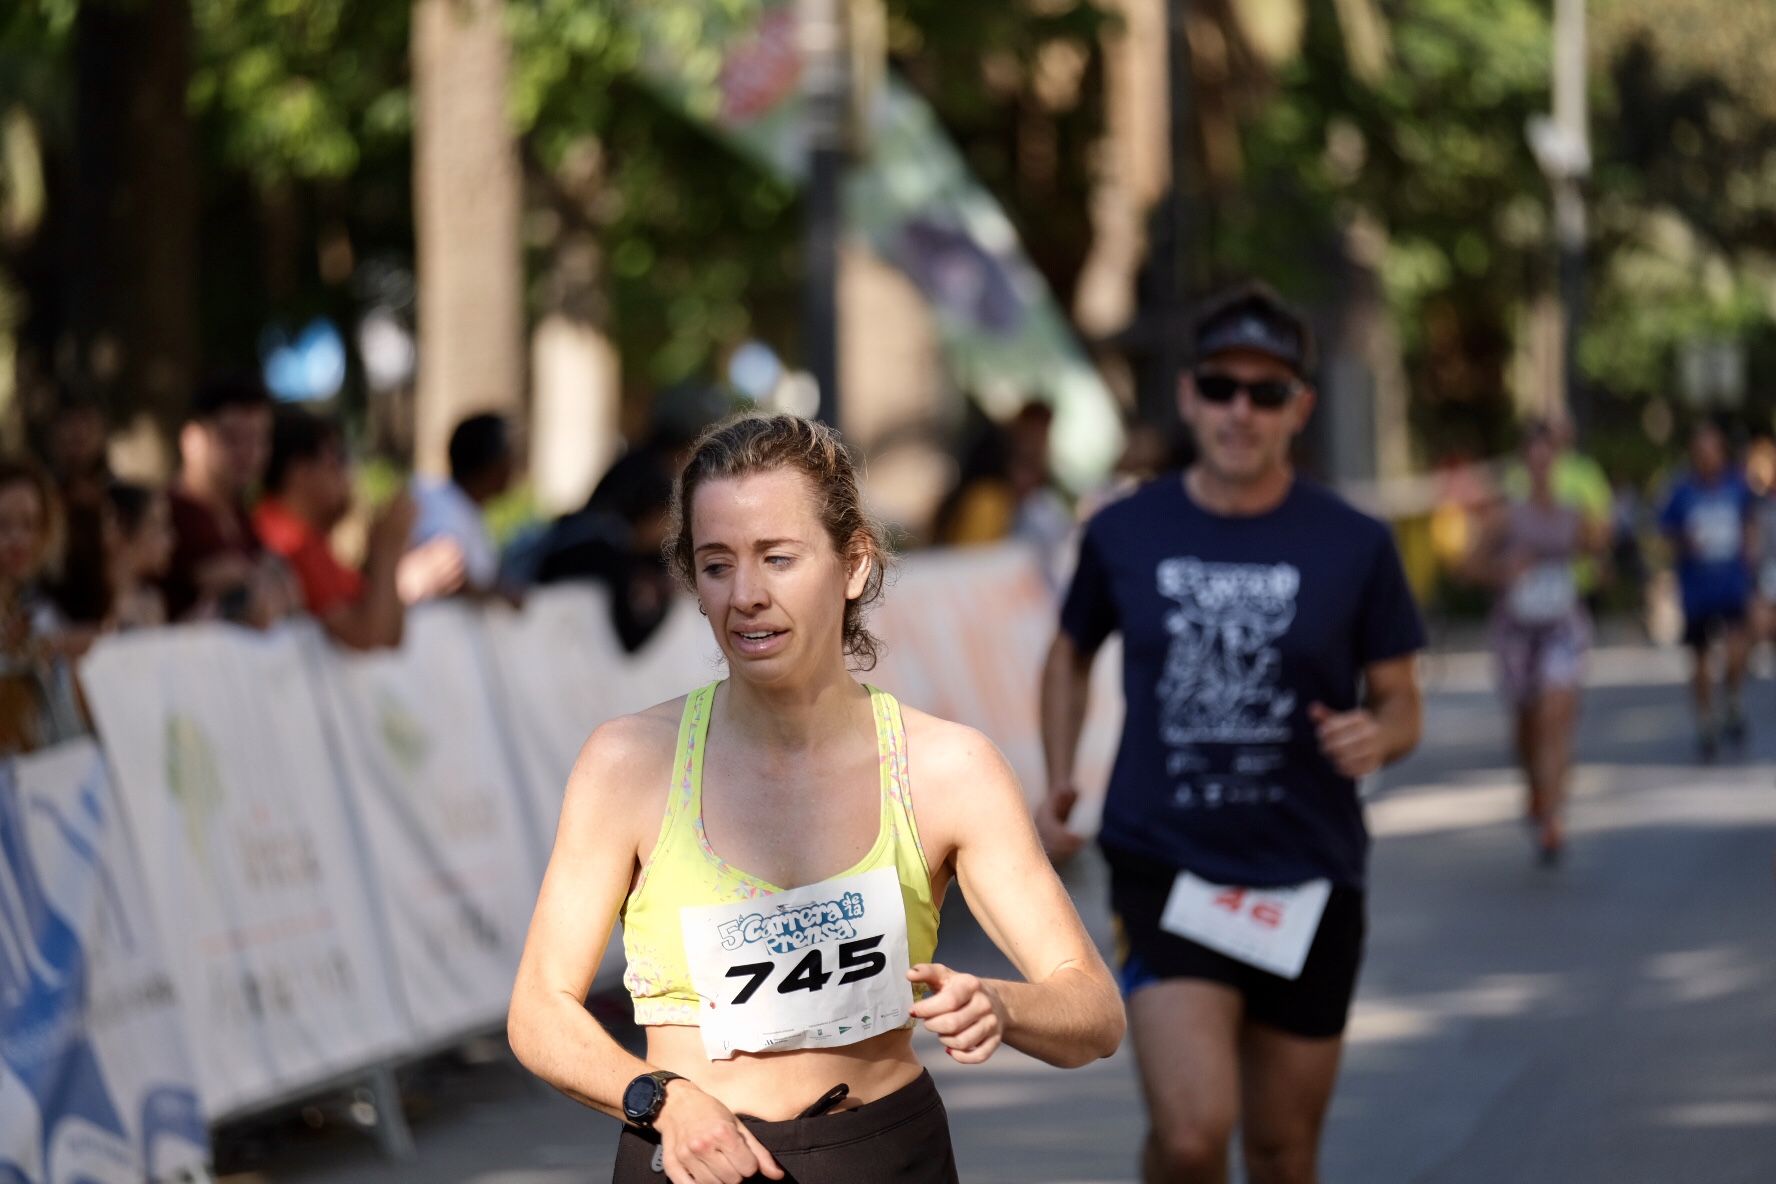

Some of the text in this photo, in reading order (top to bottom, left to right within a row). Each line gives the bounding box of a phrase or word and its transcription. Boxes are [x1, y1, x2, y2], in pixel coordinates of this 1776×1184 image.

[842, 892, 862, 907] de
[739, 901, 844, 943] Carrera
[724, 934, 886, 1005] 745
